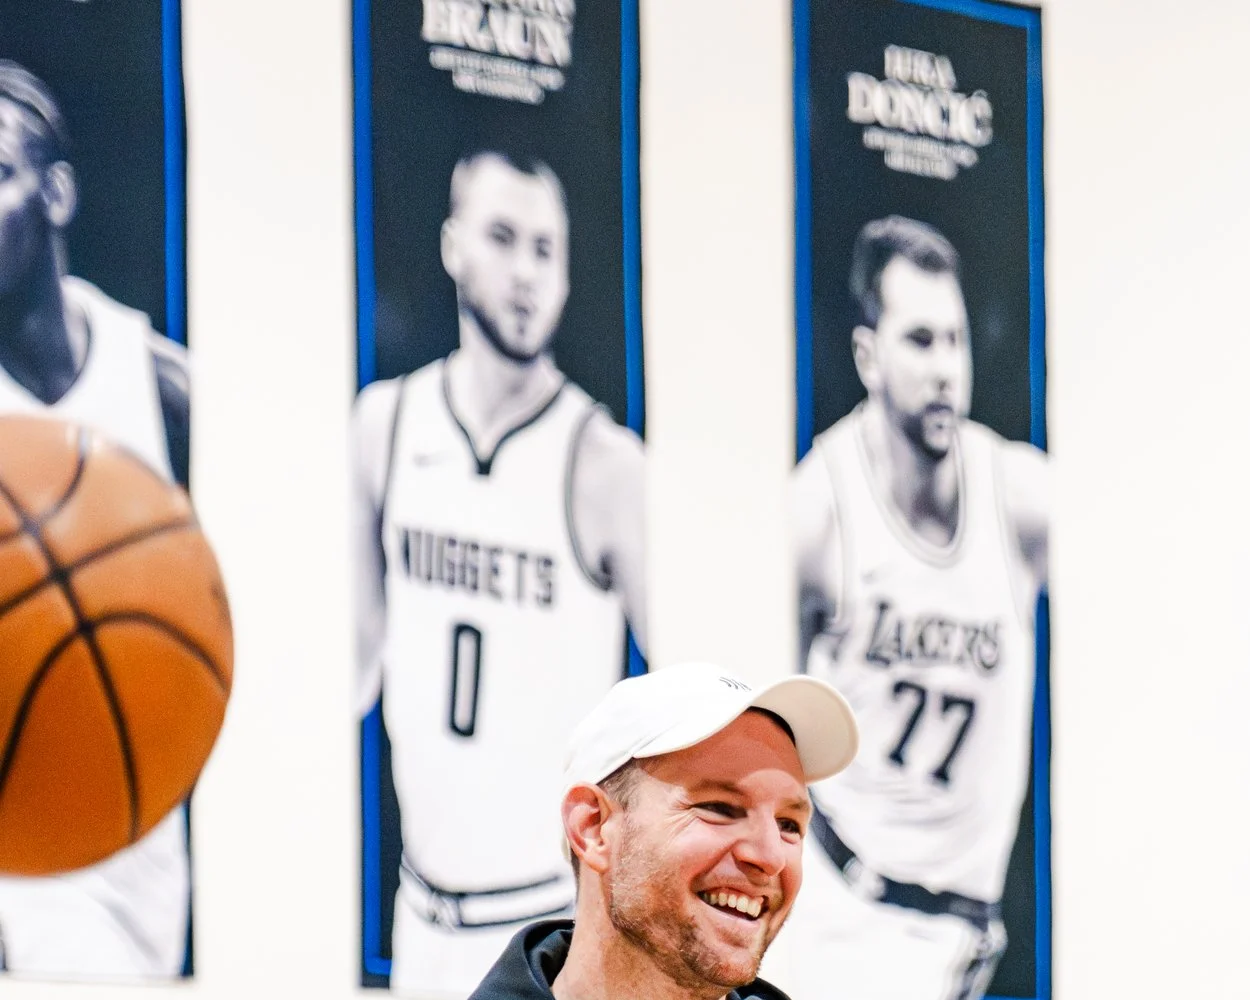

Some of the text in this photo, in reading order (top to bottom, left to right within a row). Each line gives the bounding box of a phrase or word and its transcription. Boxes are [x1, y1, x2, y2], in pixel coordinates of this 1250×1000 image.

[396, 525, 557, 607] NUGGETS
[449, 620, 483, 739] 0
[890, 680, 976, 786] 77
